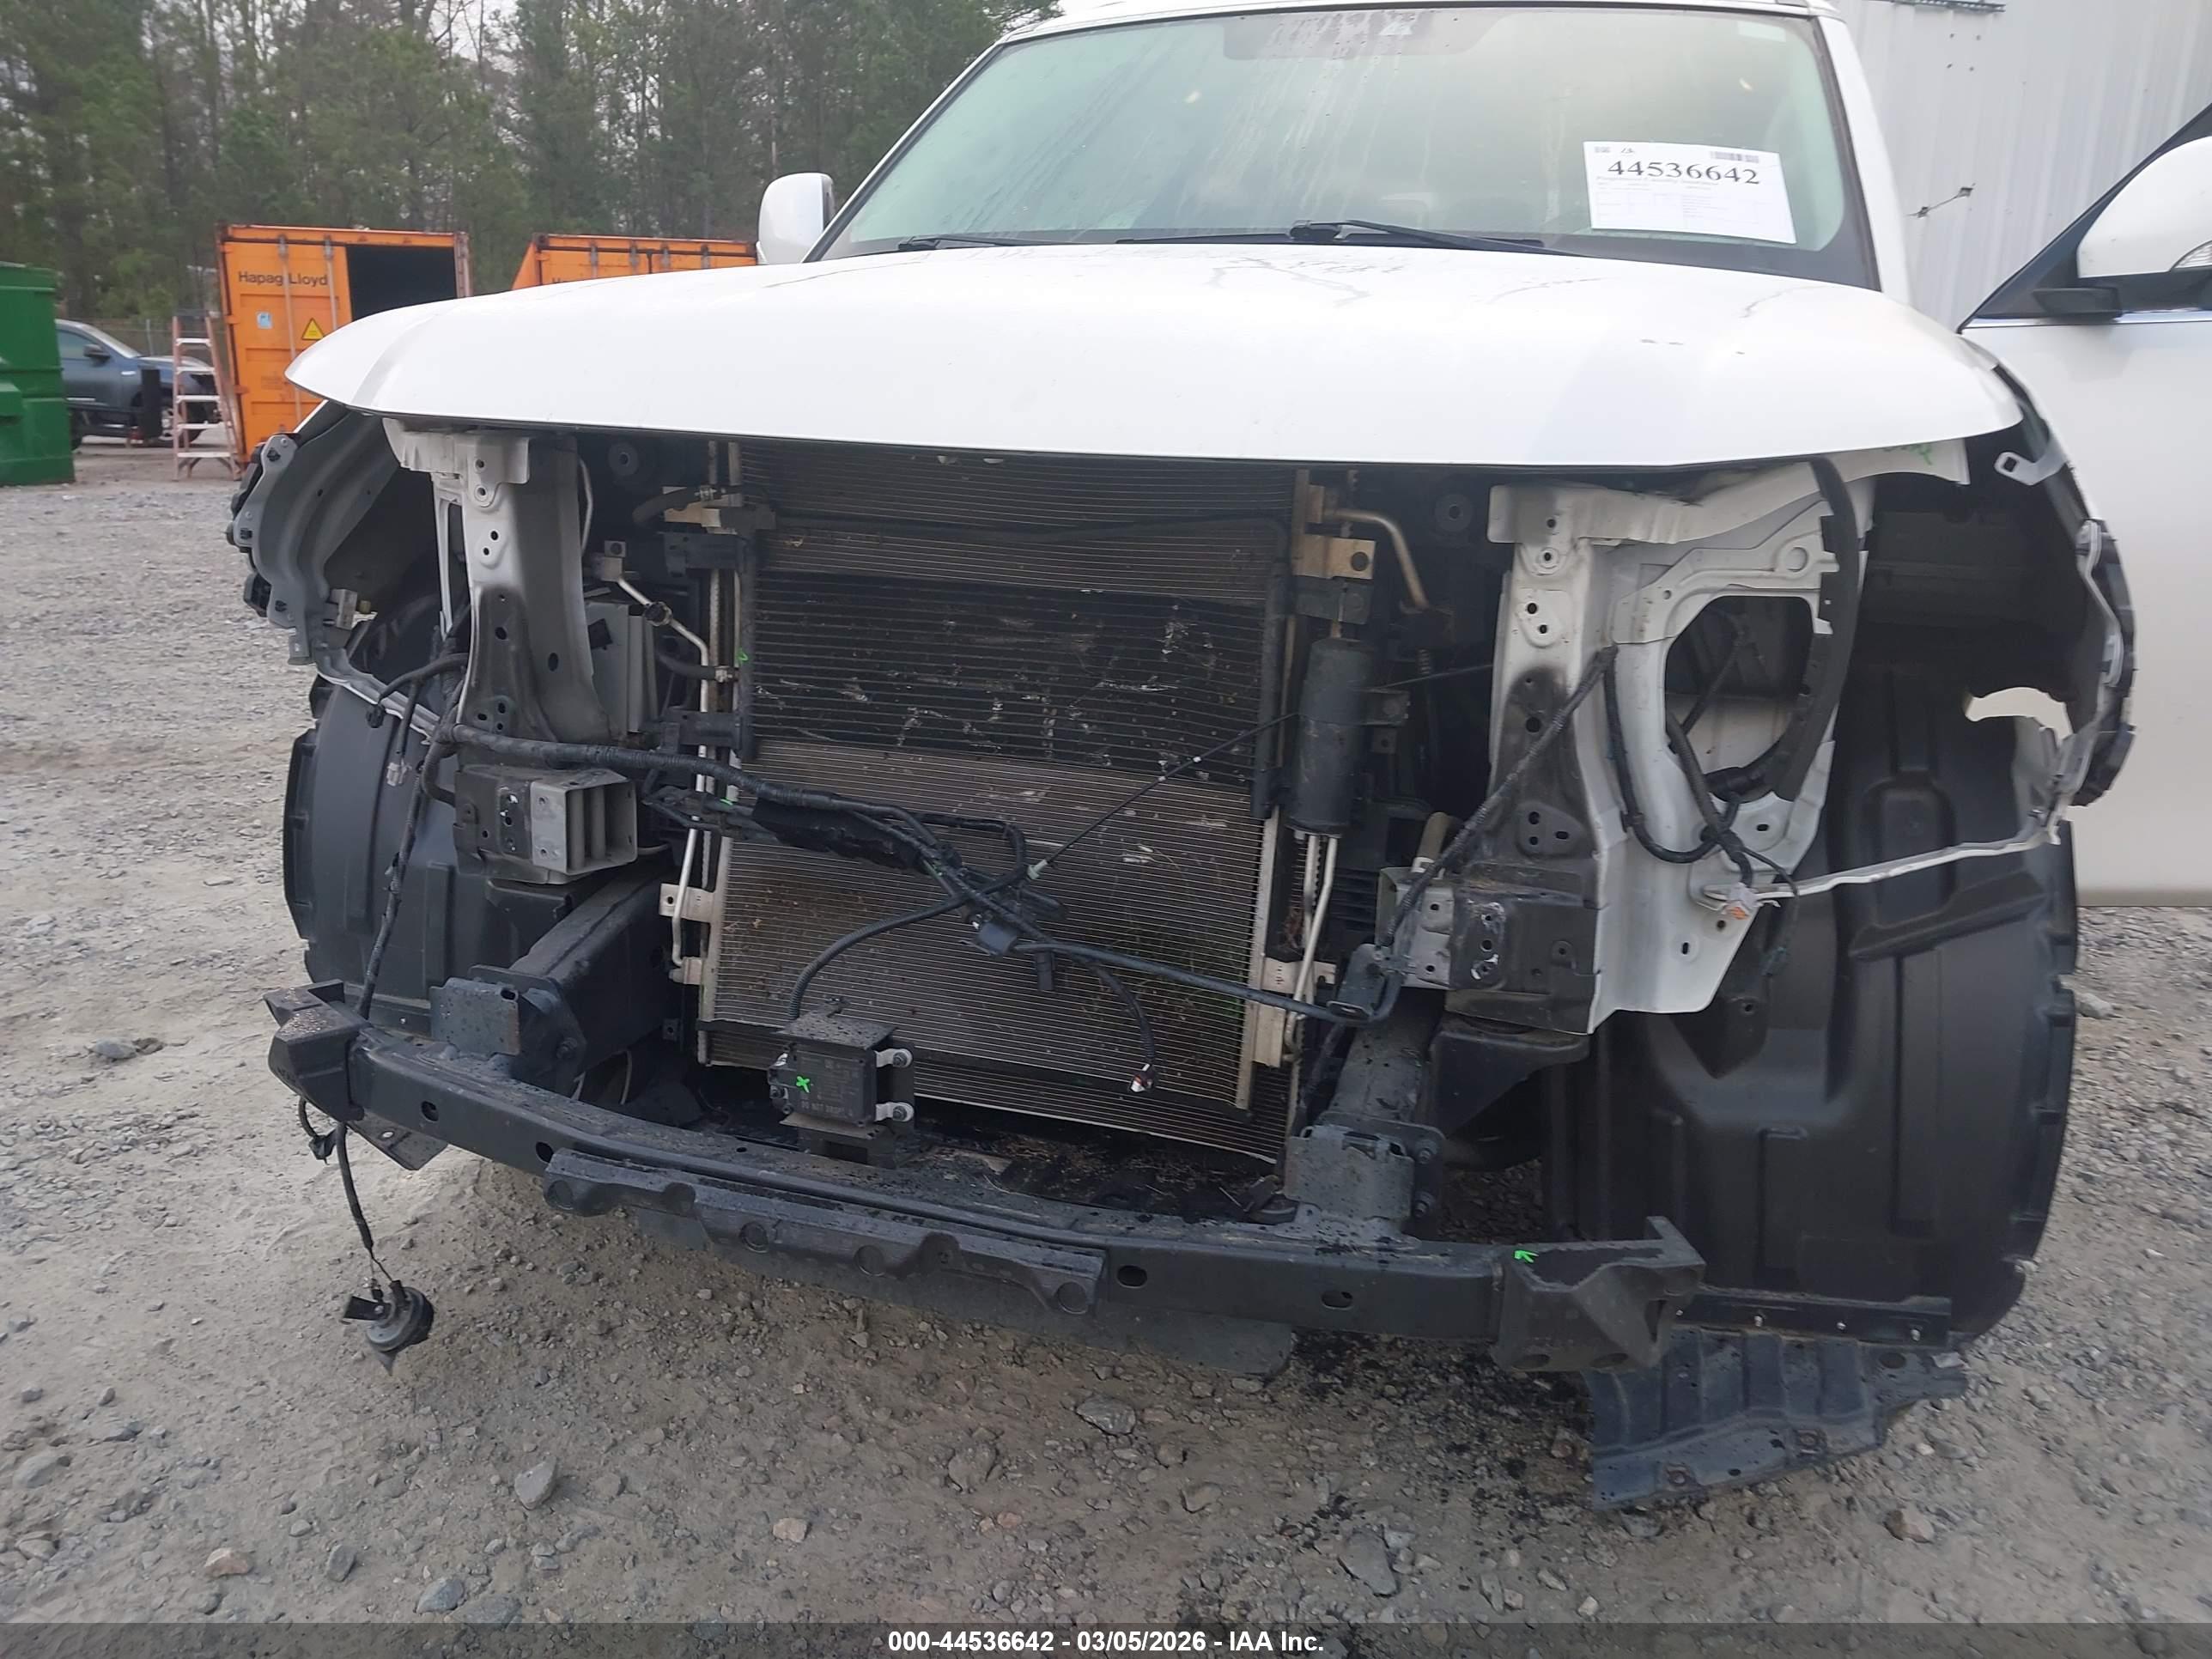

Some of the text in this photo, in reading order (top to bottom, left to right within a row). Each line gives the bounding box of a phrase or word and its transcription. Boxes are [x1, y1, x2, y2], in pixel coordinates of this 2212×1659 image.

[1607, 160, 1759, 185] 44536642
[238, 270, 328, 287] Hapag Lloyd
